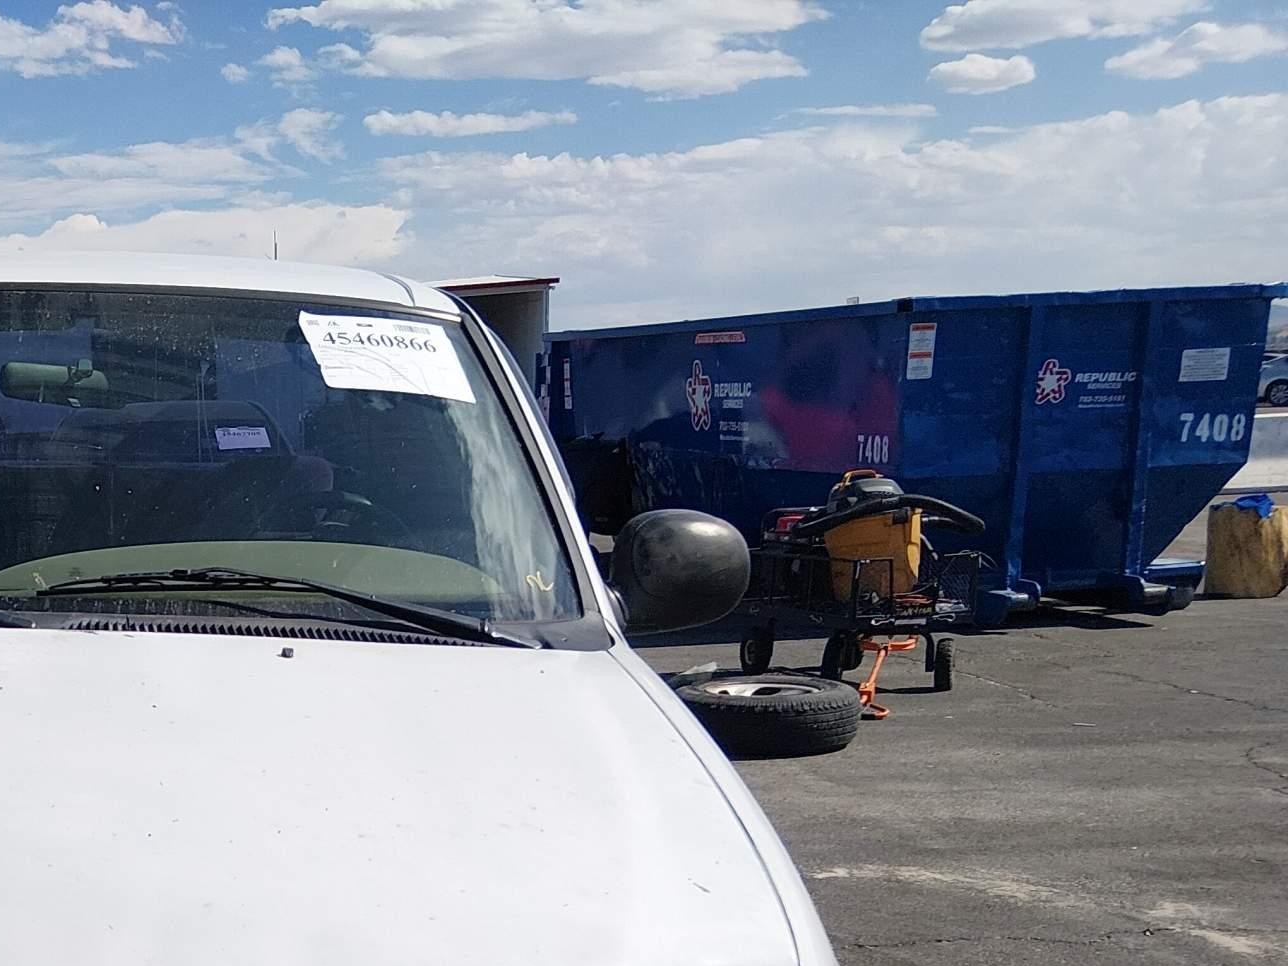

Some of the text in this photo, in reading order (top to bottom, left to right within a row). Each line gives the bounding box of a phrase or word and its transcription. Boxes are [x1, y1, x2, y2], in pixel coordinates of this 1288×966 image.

[322, 332, 437, 353] 45460866
[1074, 371, 1137, 383] REPUBLIC
[714, 382, 752, 398] REPUBLIC
[1179, 413, 1246, 442] 7408
[857, 434, 889, 464] 7408
